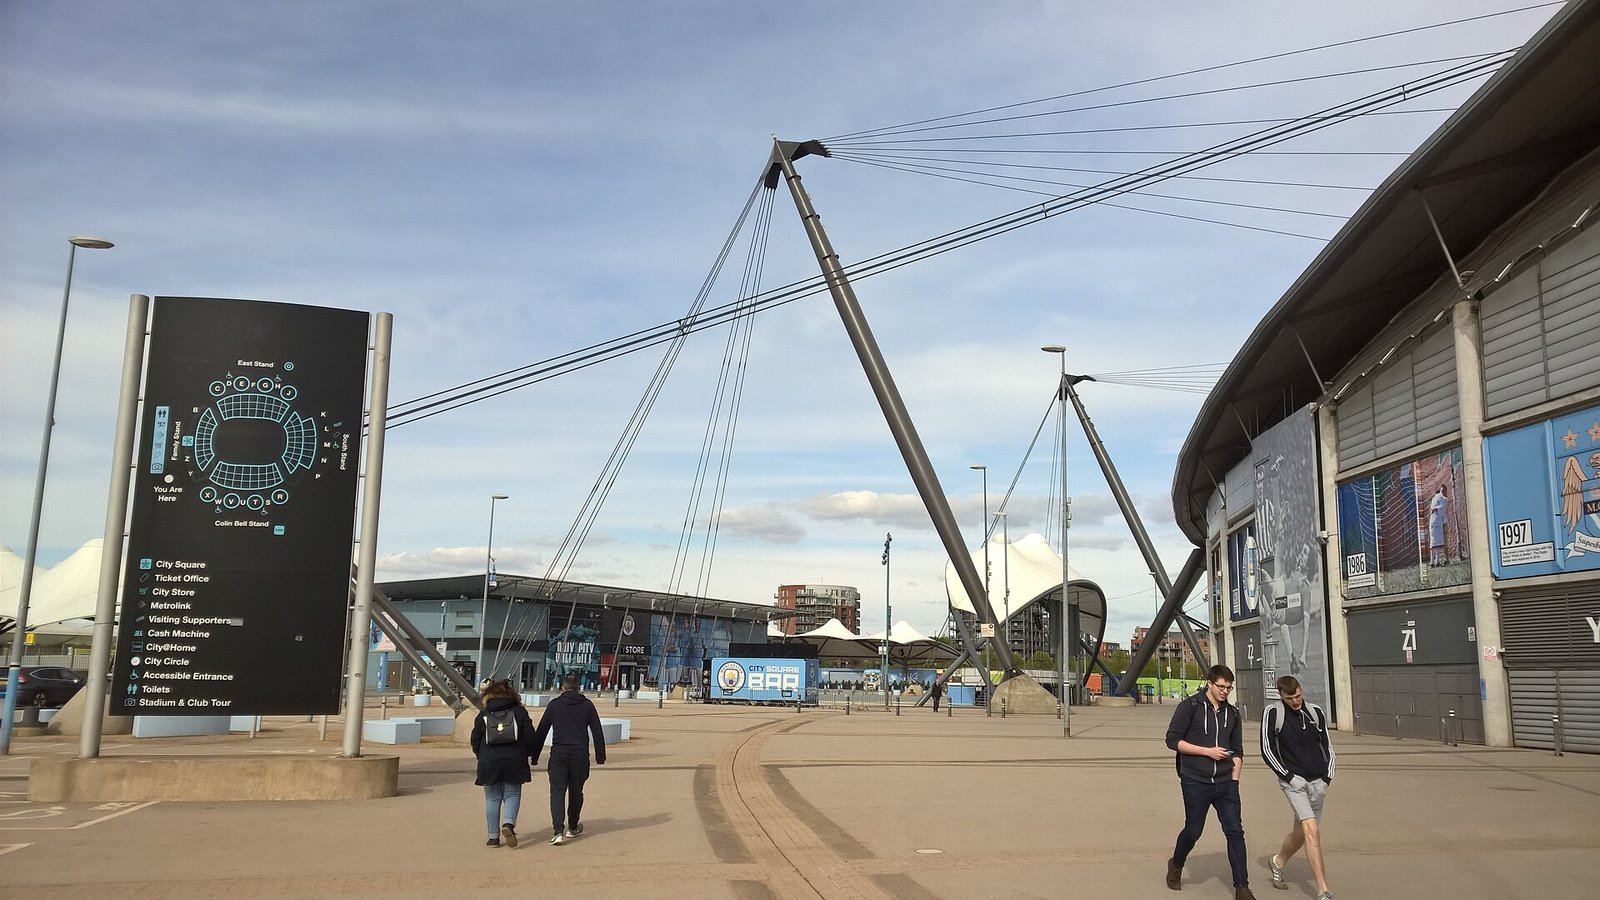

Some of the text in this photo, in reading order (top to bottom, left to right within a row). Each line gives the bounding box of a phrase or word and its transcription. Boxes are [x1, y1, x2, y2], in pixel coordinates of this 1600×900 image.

[171, 422, 181, 460] Family Stand
[1500, 522, 1527, 546] 1997
[156, 561, 205, 569] City Square
[1348, 554, 1365, 574] 1986
[155, 574, 181, 582] Ticket
[153, 588, 195, 597] City Store
[149, 616, 232, 625] Visiting Supporters
[148, 629, 210, 638] Cash Machine
[1401, 628, 1417, 651] Z1
[146, 643, 196, 652] City@Home
[625, 646, 645, 654] STORE
[145, 657, 162, 666] City
[143, 671, 191, 679] Accessible
[747, 673, 799, 692] BAR
